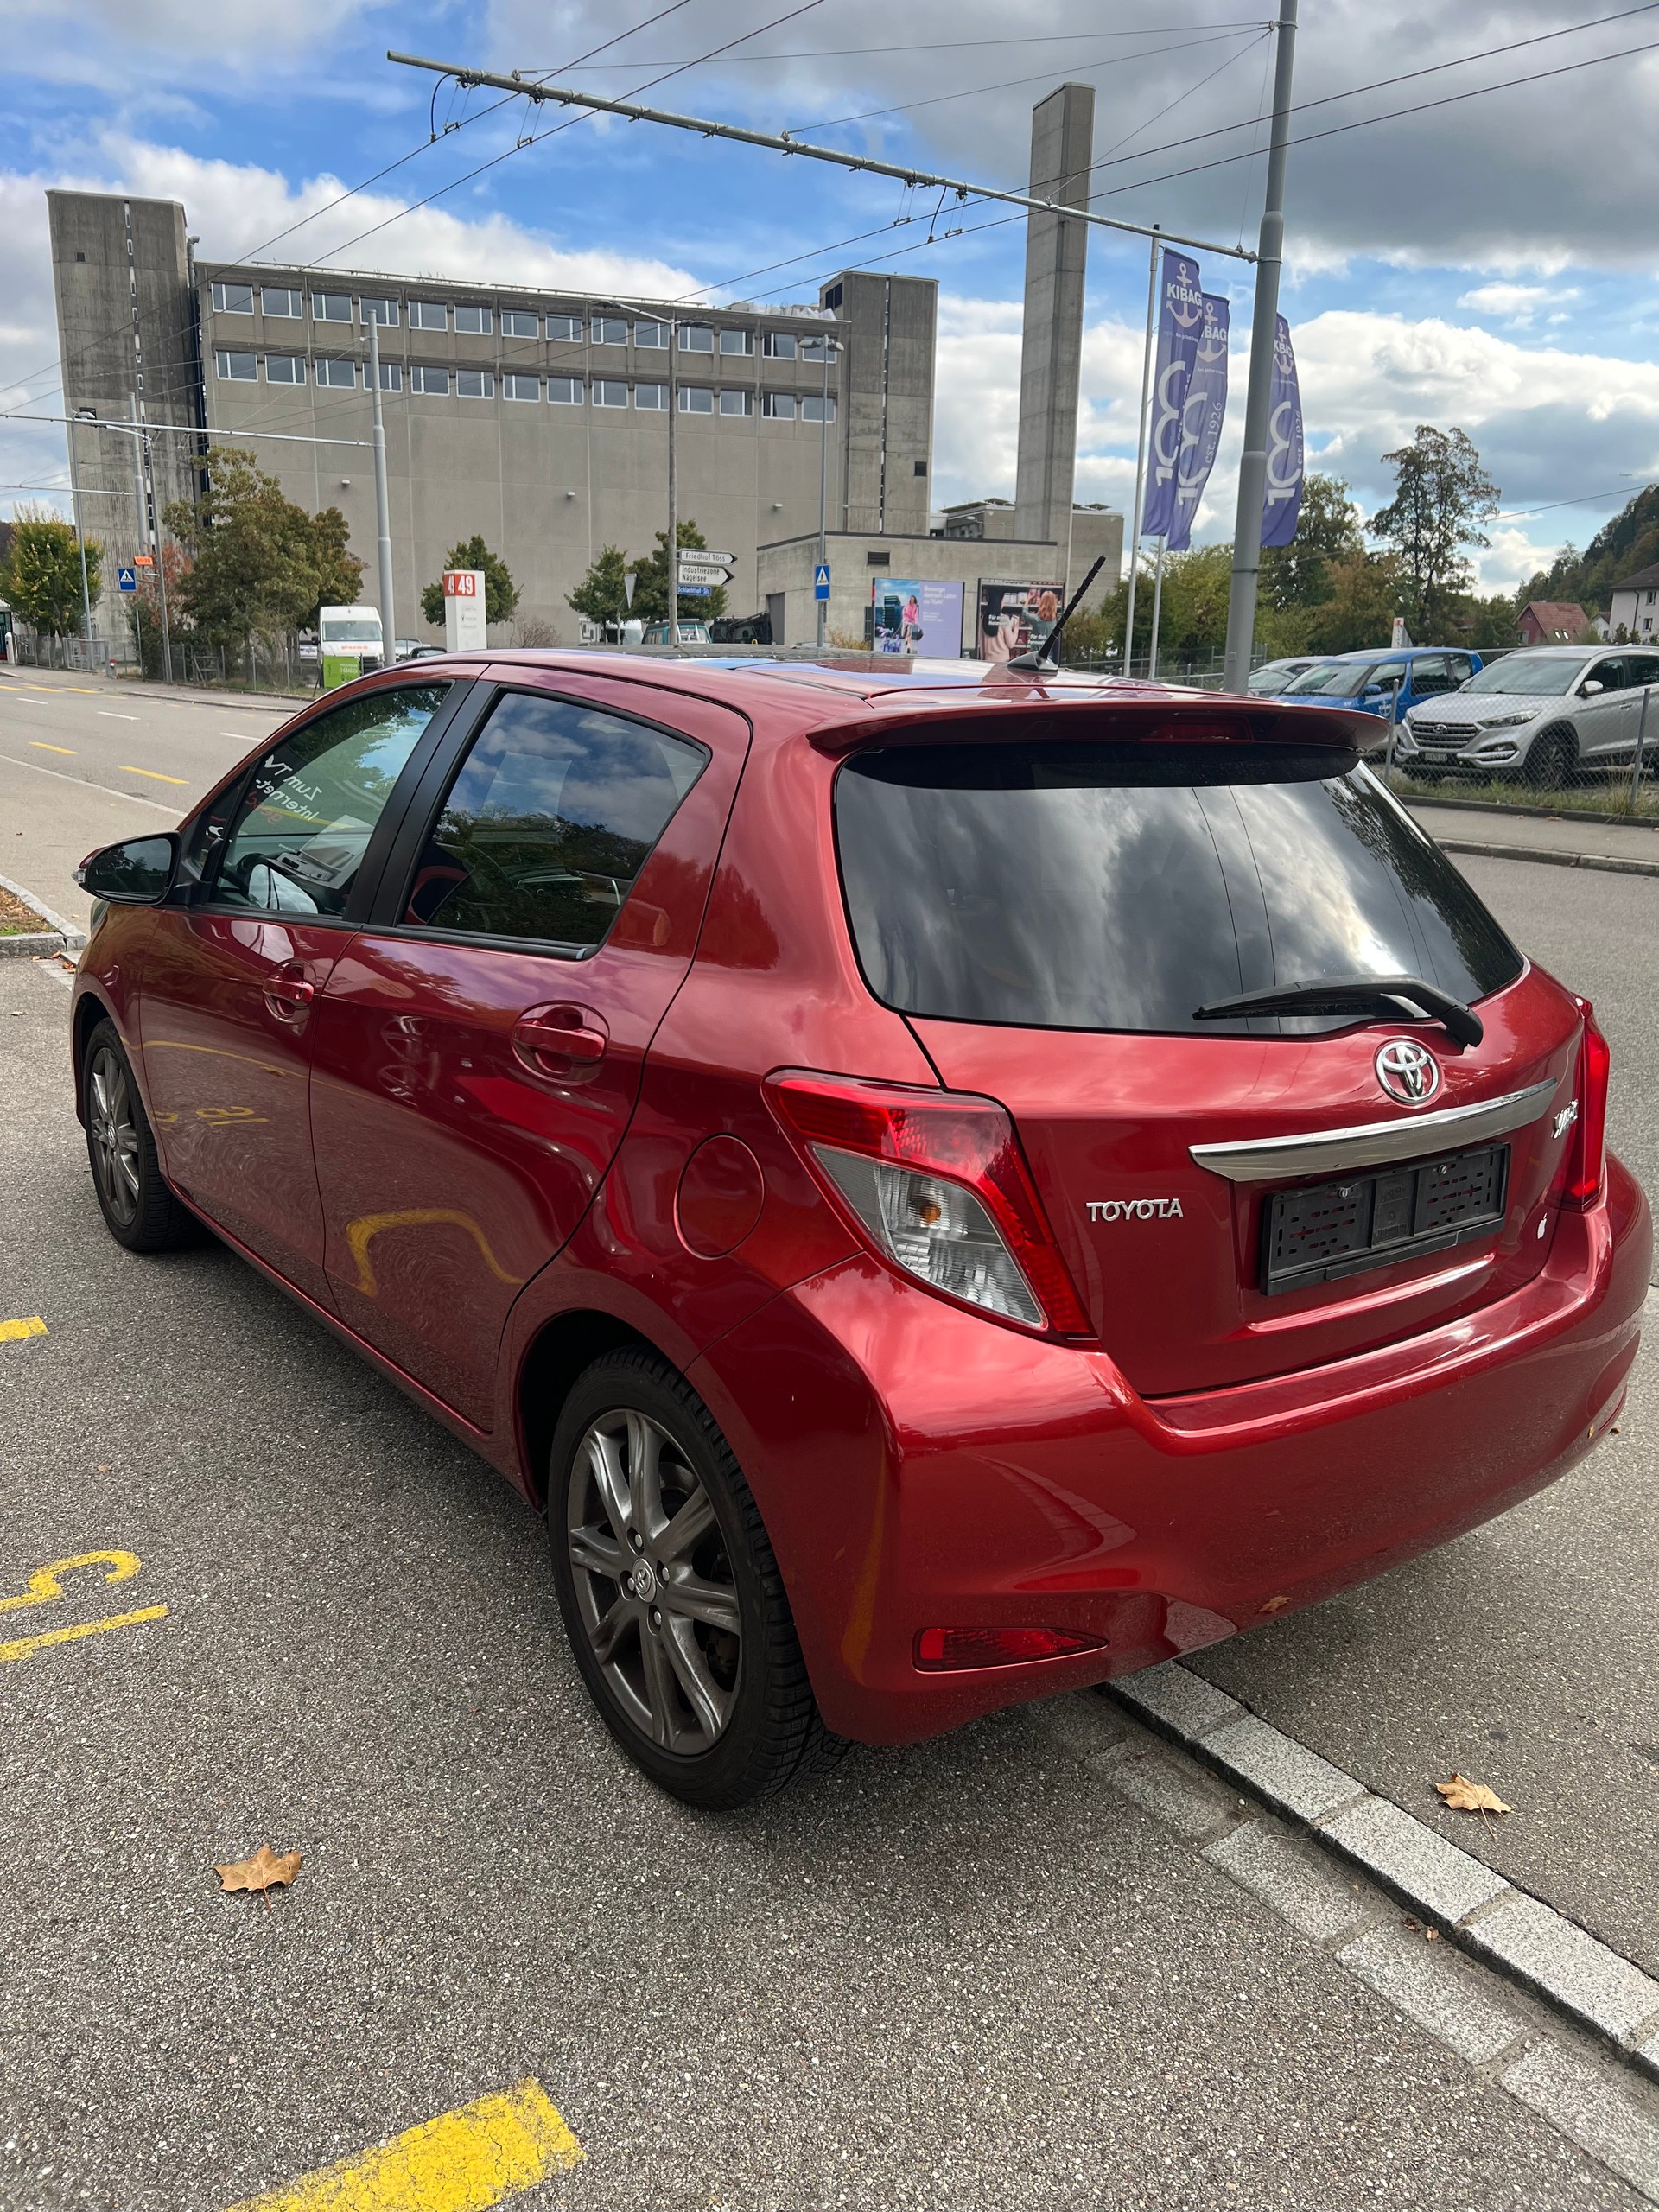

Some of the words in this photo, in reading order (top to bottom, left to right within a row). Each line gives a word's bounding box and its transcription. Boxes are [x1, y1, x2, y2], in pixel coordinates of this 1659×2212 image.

[1166, 283, 1203, 307] KIBAG
[1201, 325, 1227, 341] BAG
[1207, 402, 1223, 435] 1926
[1205, 440, 1217, 463] est.
[685, 552, 711, 562] Friedhof
[683, 565, 720, 575] Industriezone
[458, 575, 474, 594] 49
[1085, 1198, 1184, 1222] TOYOTA
